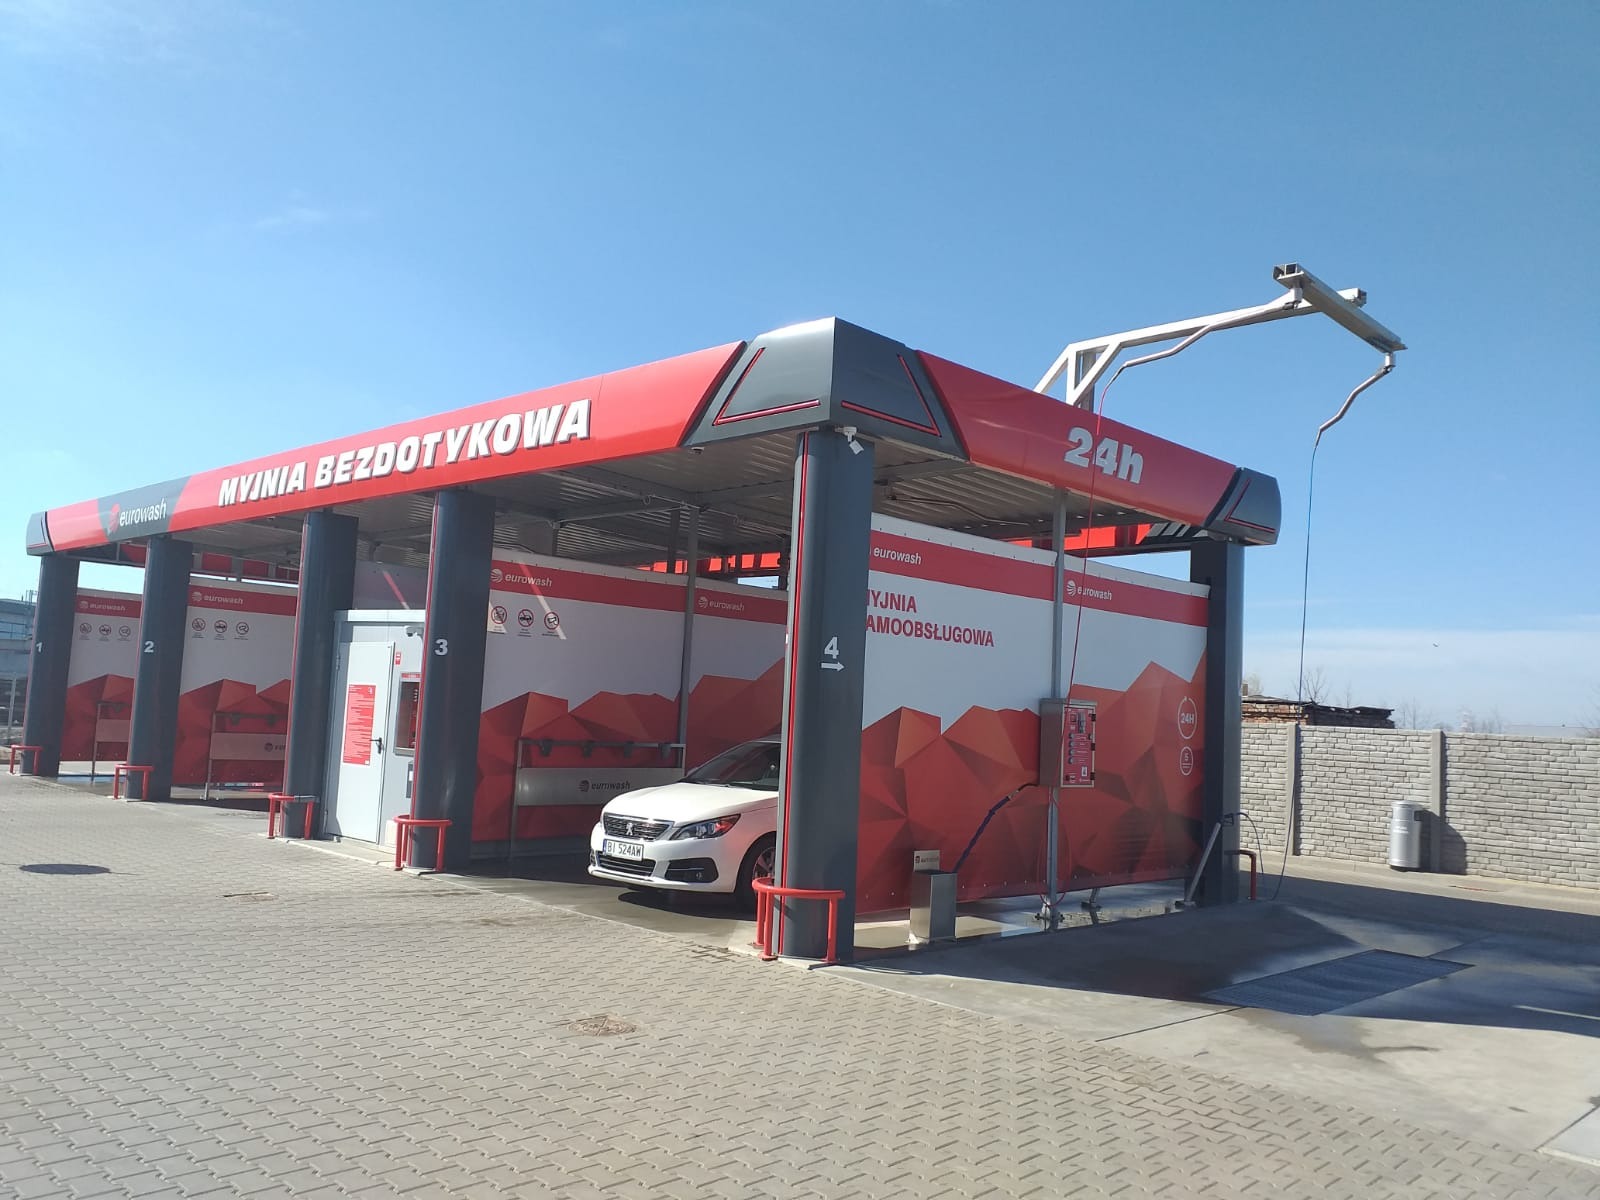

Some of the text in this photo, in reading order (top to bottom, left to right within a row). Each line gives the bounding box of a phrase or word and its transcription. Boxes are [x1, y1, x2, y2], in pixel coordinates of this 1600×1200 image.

[218, 398, 592, 508] MYJNIA BEZDOTYKOWA
[1064, 426, 1144, 485] 24h
[119, 498, 167, 527] eurowash
[873, 546, 922, 565] eurowash
[505, 573, 553, 587] eurowash
[203, 594, 244, 605] eurowash
[866, 589, 918, 613] YJNIA
[1077, 584, 1113, 601] eurowash
[708, 599, 745, 612] eurowash
[865, 614, 995, 648] AMOOBSŁUGOWA
[36, 641, 44, 653] 1
[143, 640, 154, 653] 2
[434, 639, 448, 656] 3
[823, 636, 840, 660] 4
[1180, 712, 1195, 724] 24H
[607, 842, 641, 857] BI 524AW
